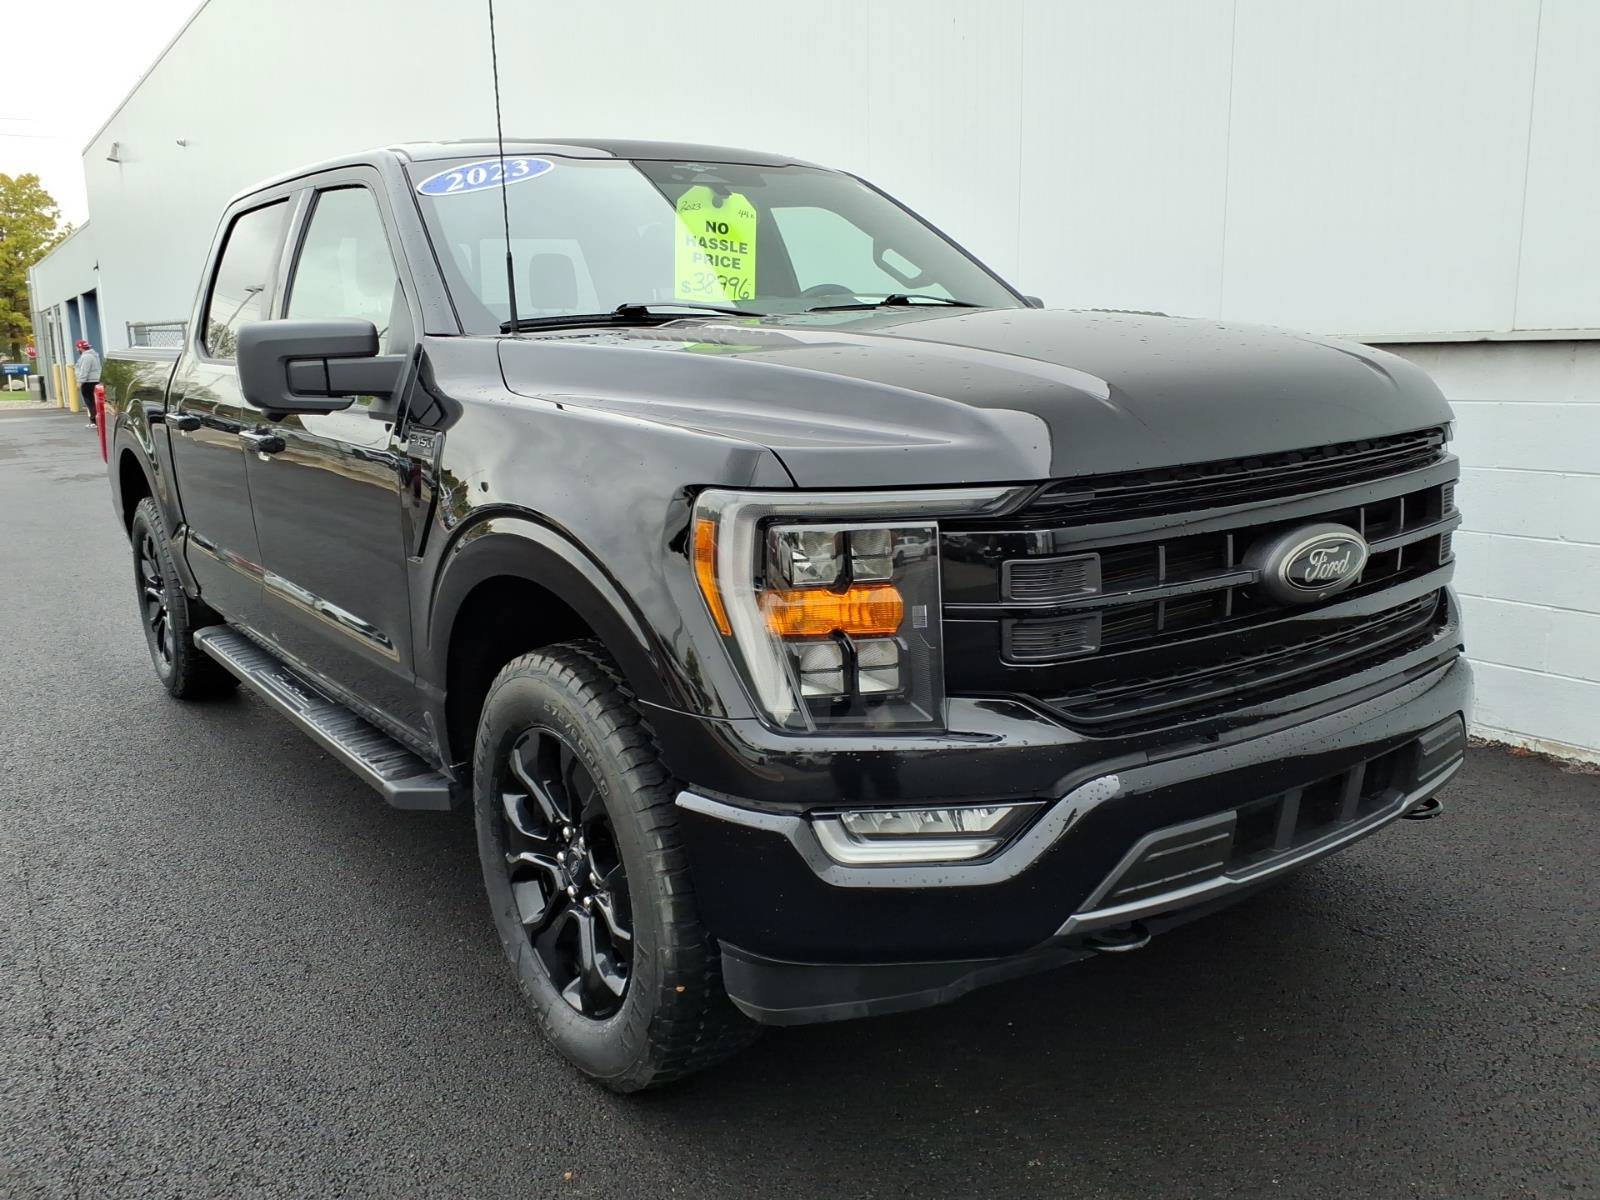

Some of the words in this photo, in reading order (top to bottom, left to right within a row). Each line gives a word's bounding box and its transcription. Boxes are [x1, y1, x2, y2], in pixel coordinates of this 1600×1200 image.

[446, 159, 530, 192] 2023
[705, 220, 729, 235] NO
[686, 235, 748, 254] HASSLE
[693, 252, 741, 270] PRICE
[1304, 546, 1351, 583] Ford
